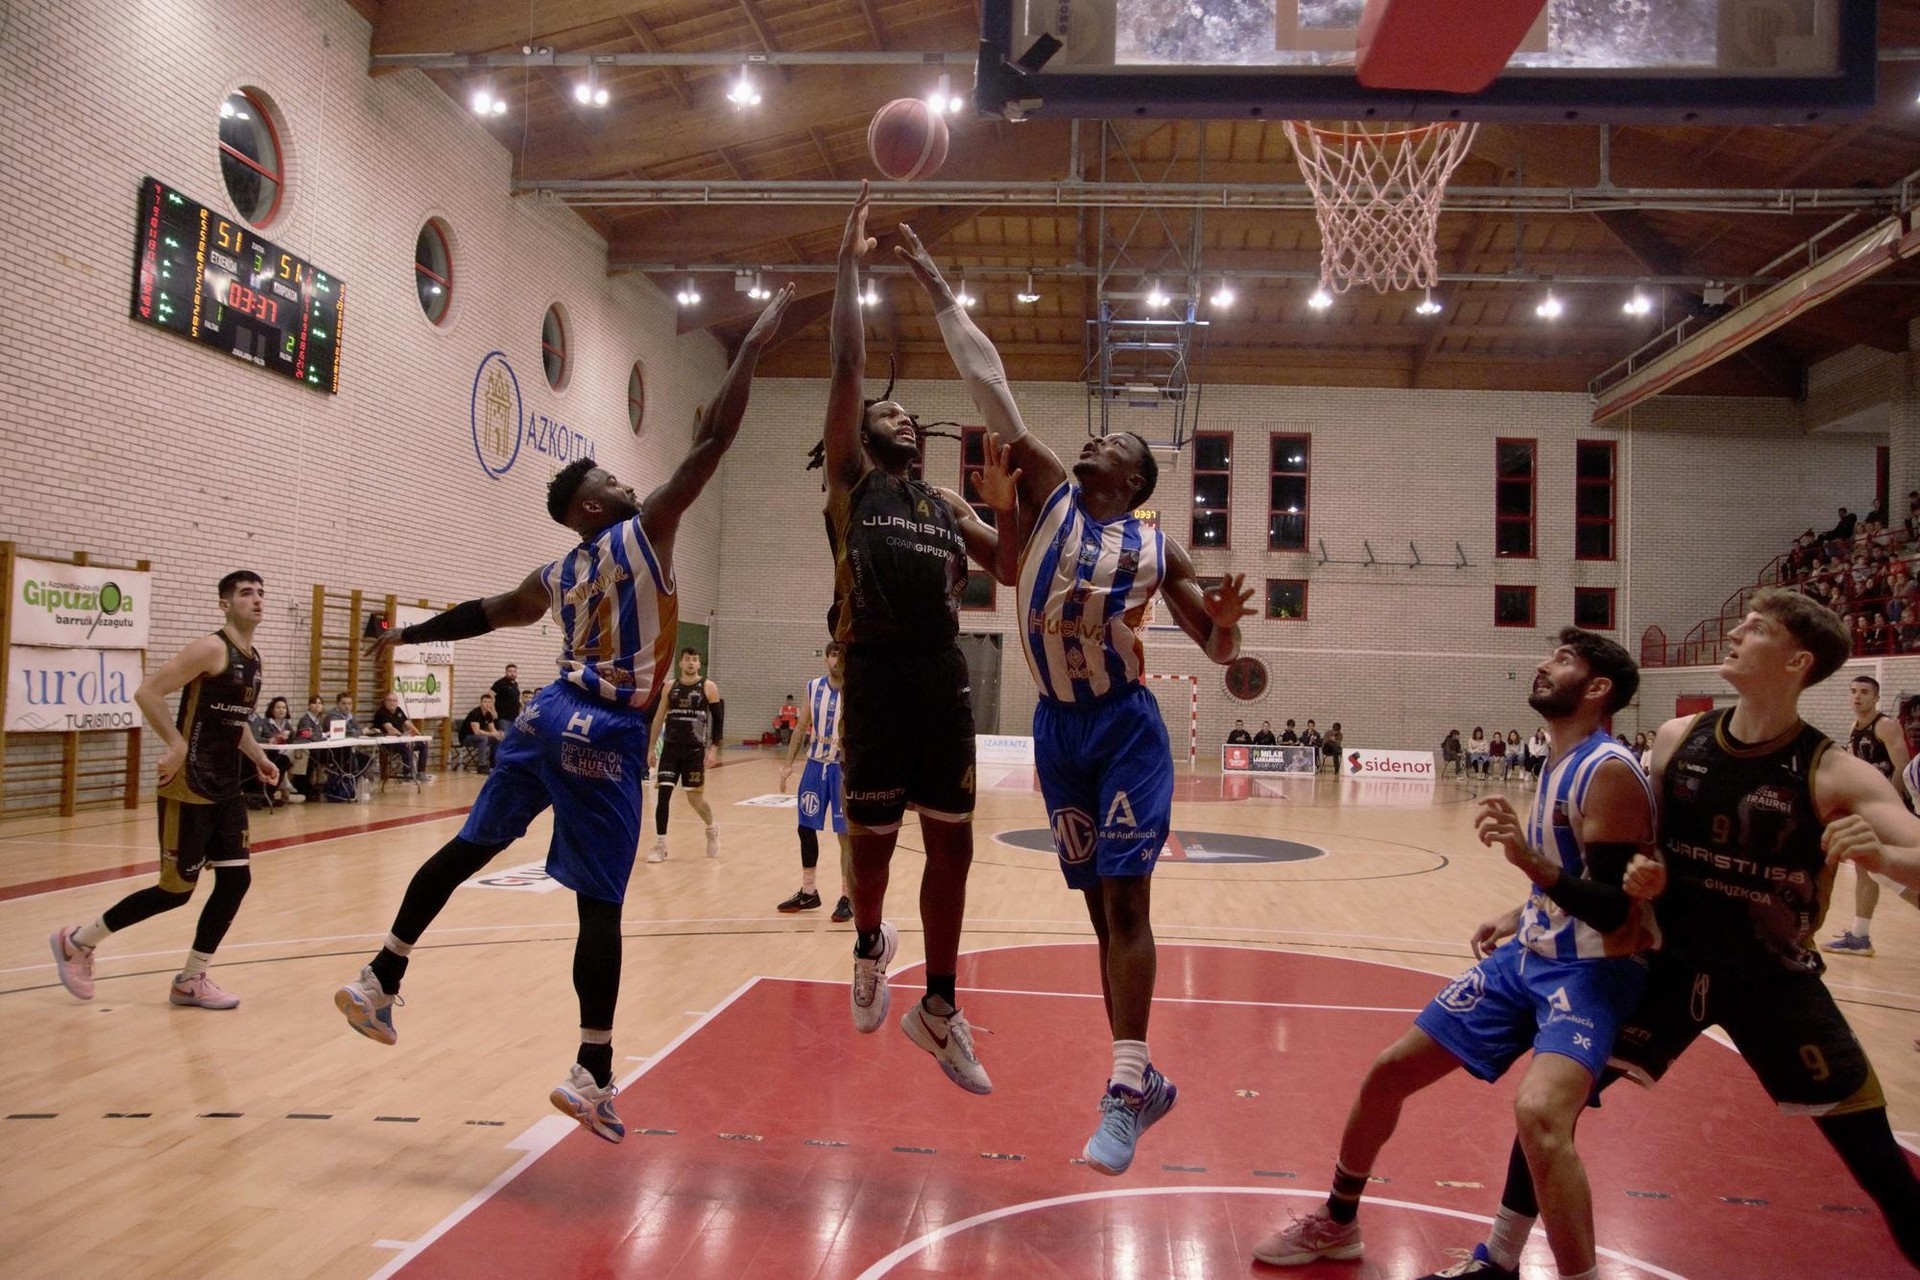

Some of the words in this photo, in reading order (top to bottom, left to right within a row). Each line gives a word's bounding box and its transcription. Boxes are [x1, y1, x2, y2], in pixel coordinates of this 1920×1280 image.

[218, 221, 243, 253] 51
[280, 254, 303, 283] 51
[229, 281, 278, 323] 03:37
[526, 412, 596, 466] AZKOITIA
[917, 499, 931, 518] 4
[862, 515, 951, 541] JUARISTI
[23, 652, 130, 706] urola
[561, 752, 574, 765] DE
[578, 758, 622, 775] HUELVA
[1365, 757, 1432, 773] sidenor
[1746, 794, 1792, 814] IRAURGI
[1800, 1044, 1830, 1082] 9
